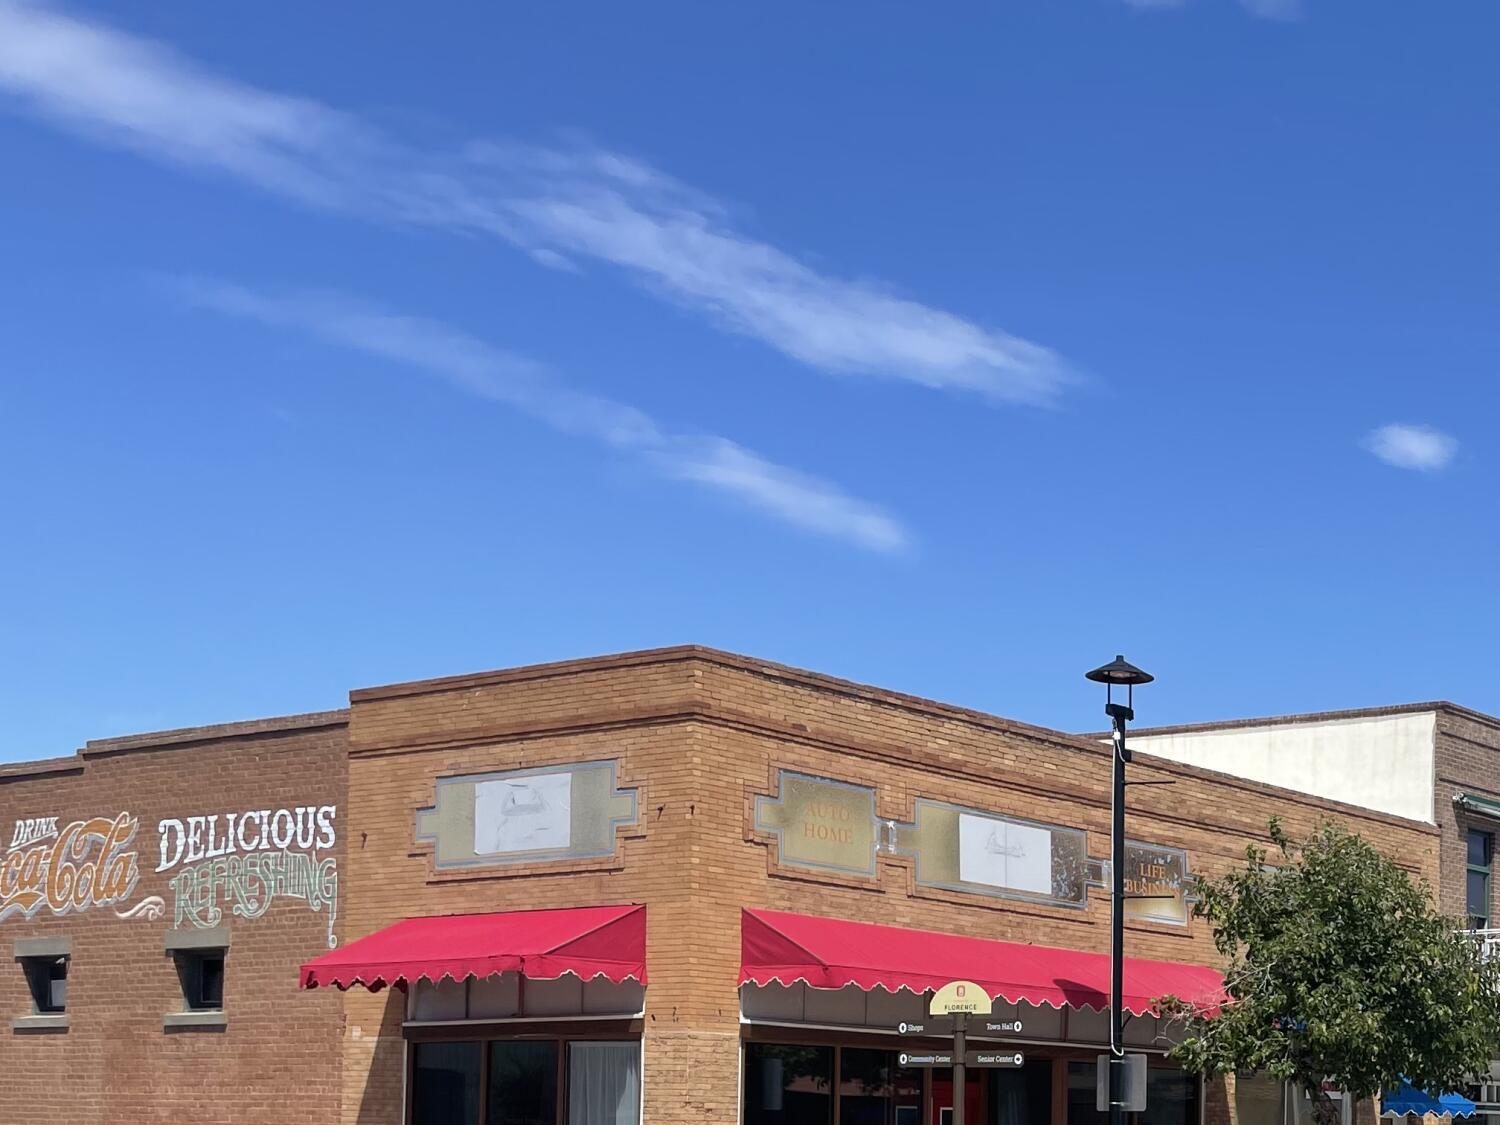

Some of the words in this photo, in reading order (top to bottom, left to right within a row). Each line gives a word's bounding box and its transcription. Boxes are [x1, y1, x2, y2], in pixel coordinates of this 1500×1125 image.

[804, 801, 850, 822] AUTO
[10, 816, 59, 847] DRINK
[155, 806, 336, 873] DELICIOUS
[804, 823, 854, 844] HOME
[0, 811, 140, 920] ca-Cola
[1140, 863, 1167, 879] LIFE
[169, 850, 338, 949] REFRESHING
[907, 1024, 924, 1032] Shops
[986, 1023, 1001, 1031] Town
[908, 1055, 935, 1063] Community
[977, 1055, 995, 1063] Senior
